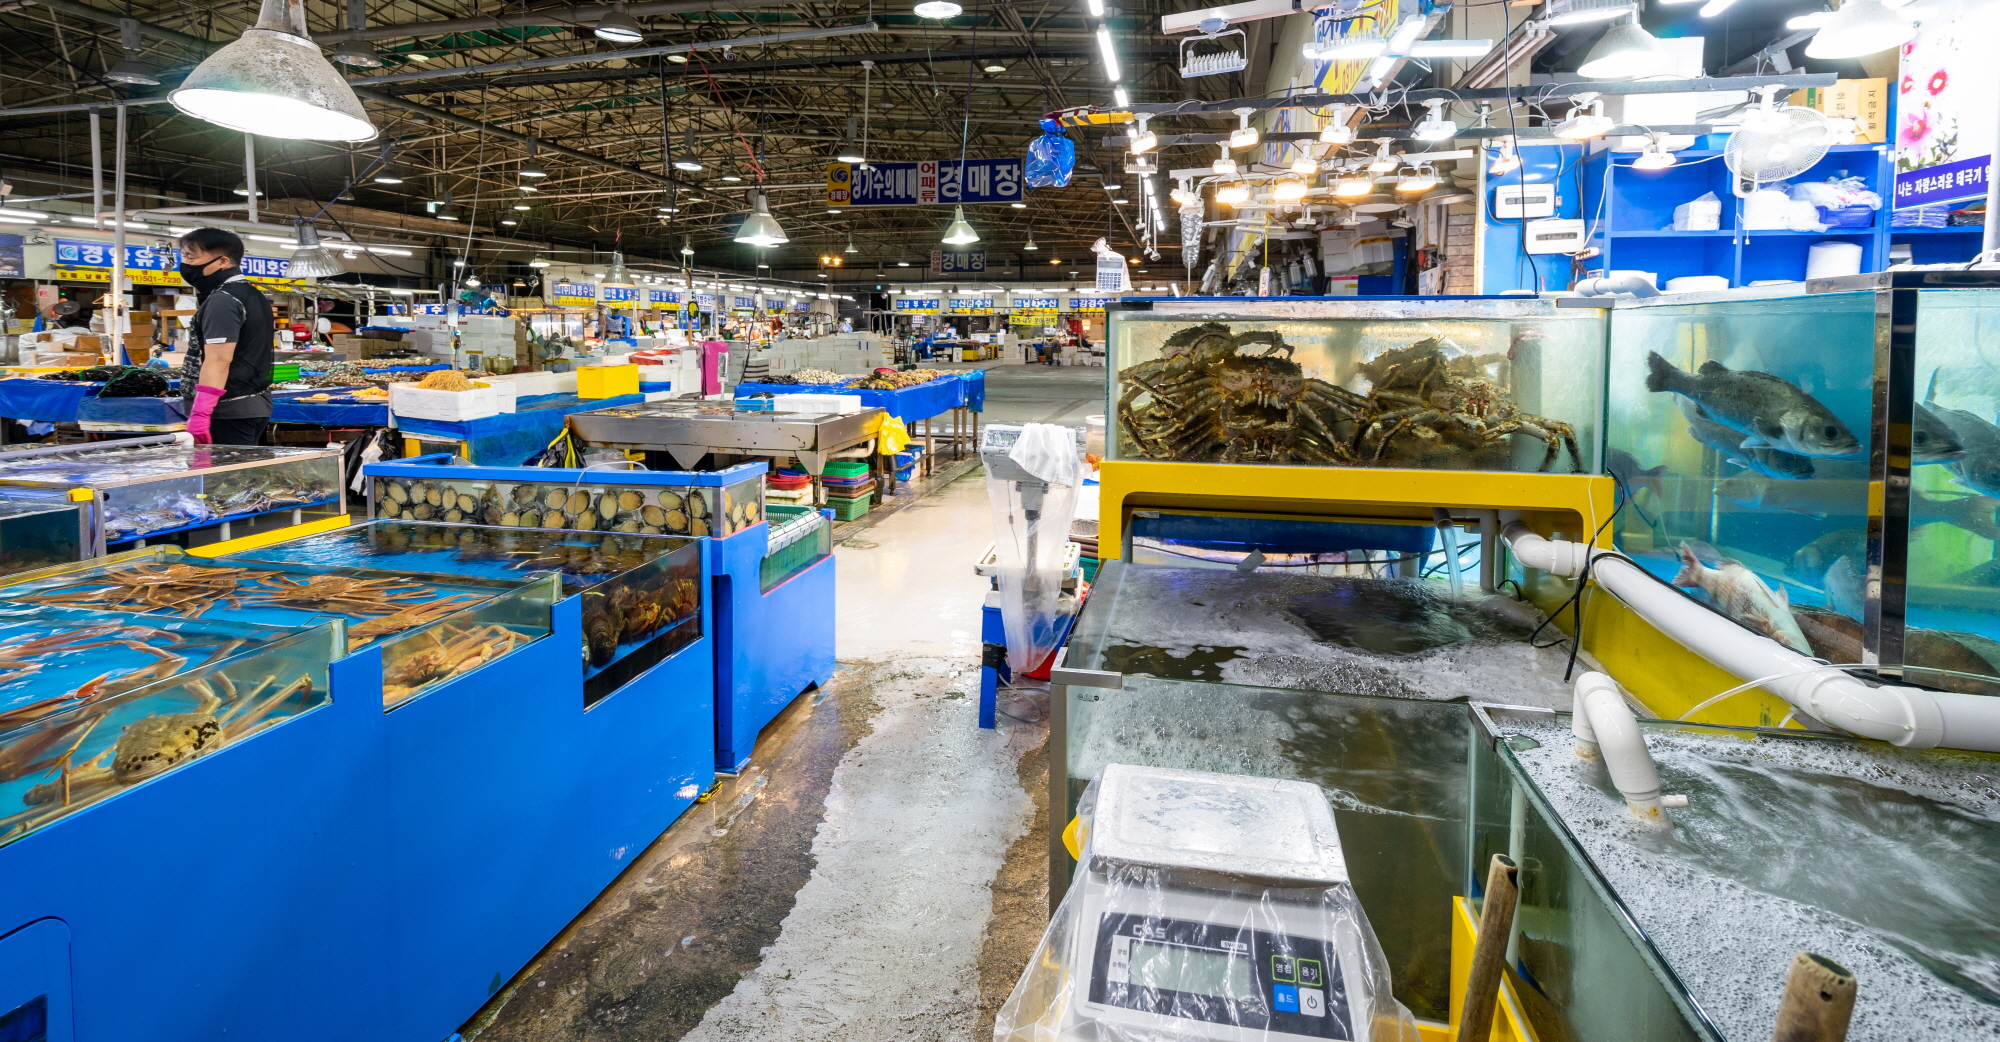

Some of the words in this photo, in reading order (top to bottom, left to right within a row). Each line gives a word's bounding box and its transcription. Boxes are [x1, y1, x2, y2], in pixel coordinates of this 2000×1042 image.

[851, 168, 917, 200] 정가수의매매
[920, 162, 937, 202] 어패류
[940, 164, 1021, 198] 경매장
[1898, 181, 1913, 197] 나는
[1914, 172, 1954, 194] 자랑스러운
[1956, 166, 1982, 186] 태극기
[830, 190, 848, 200] 경매장
[943, 253, 985, 270] 경매장
[1275, 962, 1292, 975] 영점
[1301, 966, 1318, 978] 용기
[1277, 992, 1294, 1004] 홀드
